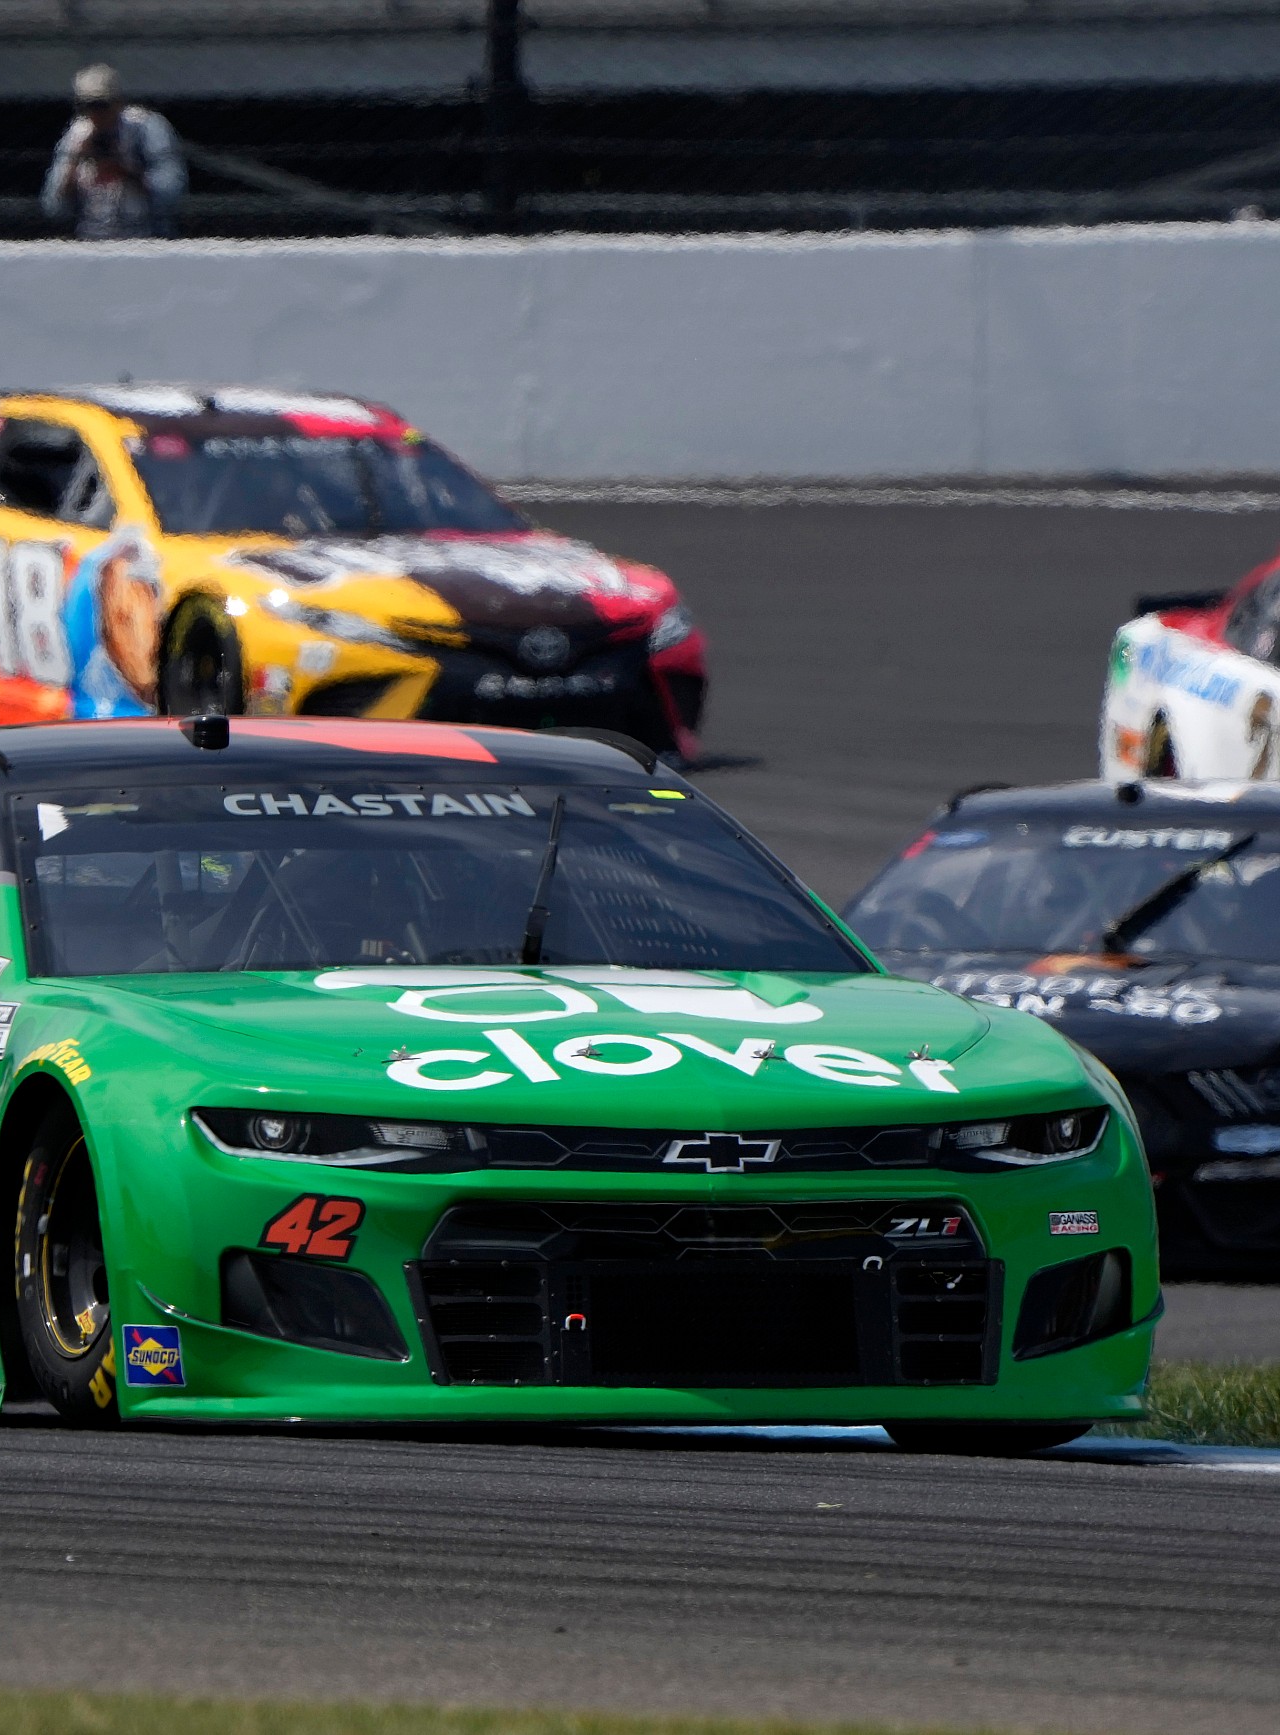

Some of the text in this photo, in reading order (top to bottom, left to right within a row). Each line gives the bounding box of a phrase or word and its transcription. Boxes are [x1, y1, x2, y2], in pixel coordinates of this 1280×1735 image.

[223, 793, 536, 817] CHASTAIN
[1062, 827, 1233, 850] CUSTER
[386, 1029, 960, 1093] clover
[262, 1195, 364, 1260] 42
[883, 1217, 962, 1238] ZL1
[1051, 1224, 1098, 1234] RACING
[129, 1348, 180, 1365] SUNOCO
